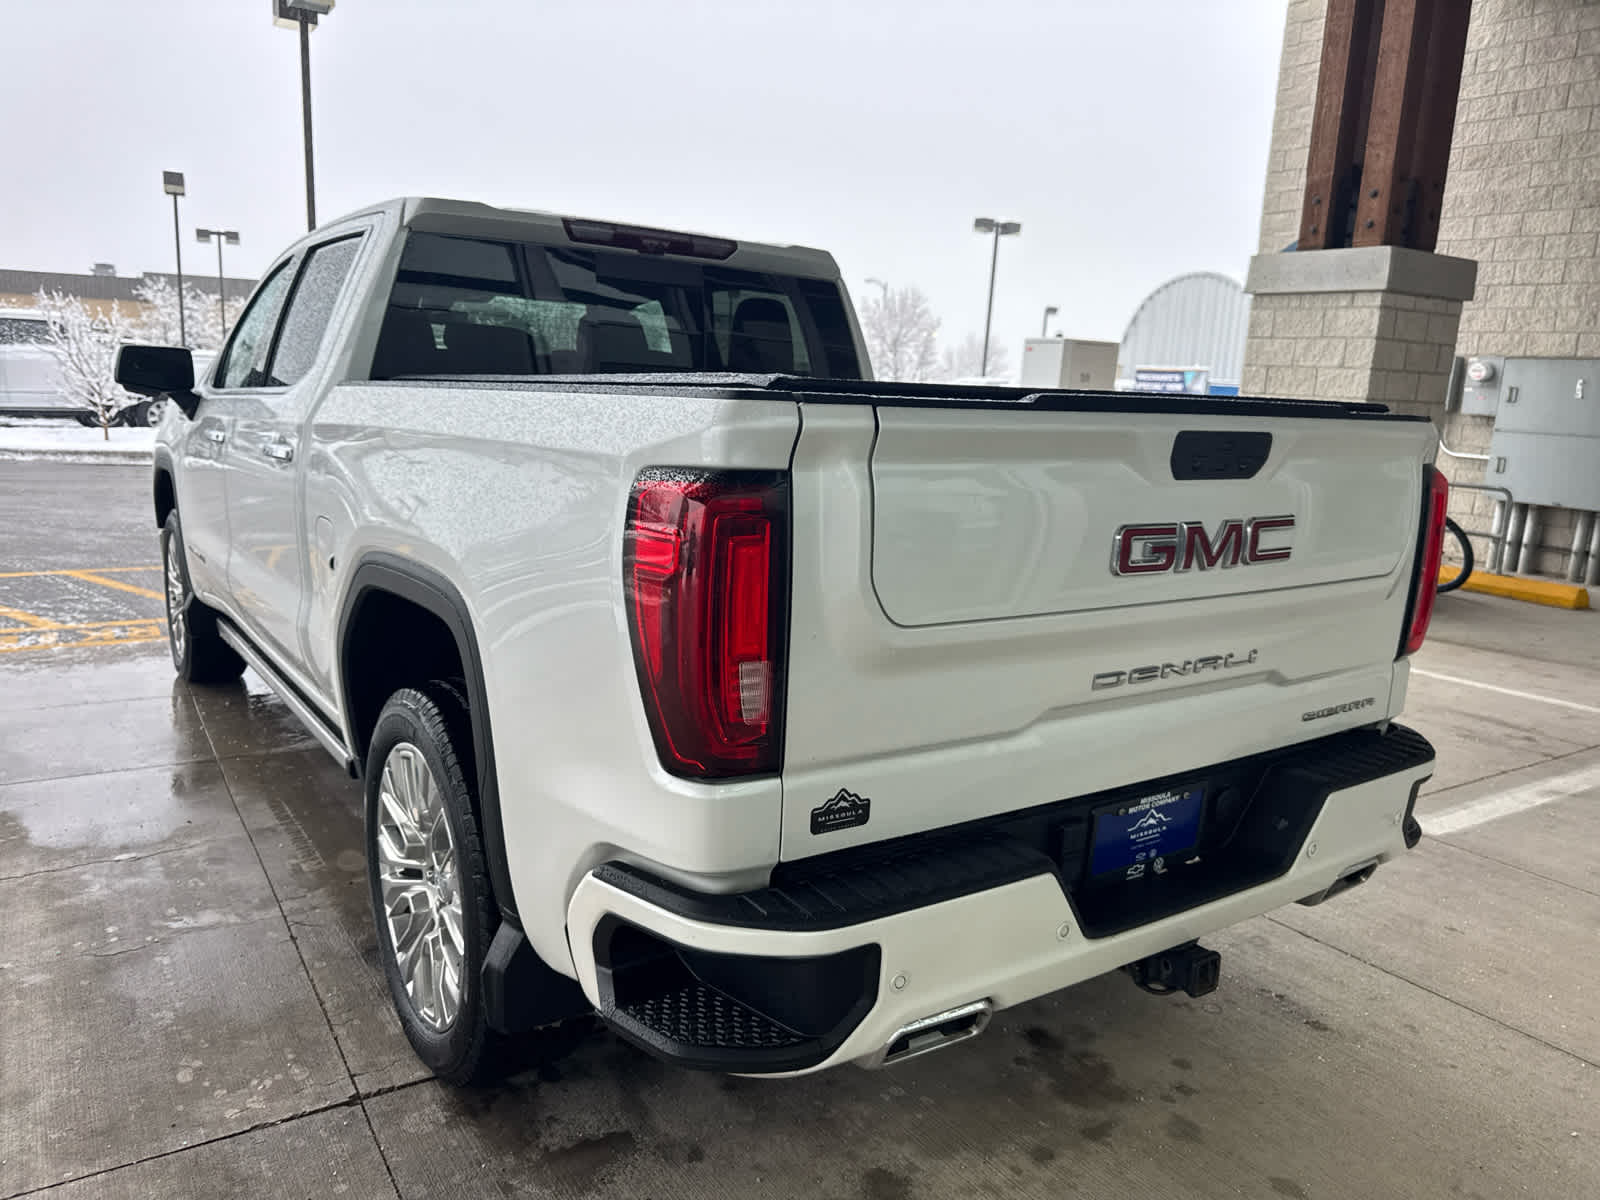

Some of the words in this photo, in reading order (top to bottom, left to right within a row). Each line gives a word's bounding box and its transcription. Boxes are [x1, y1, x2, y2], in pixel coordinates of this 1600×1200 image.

[1109, 513, 1296, 577] GMC
[1091, 648, 1258, 691] DENALI
[1302, 697, 1376, 722] SIERRA
[817, 809, 864, 822] MISSOULA
